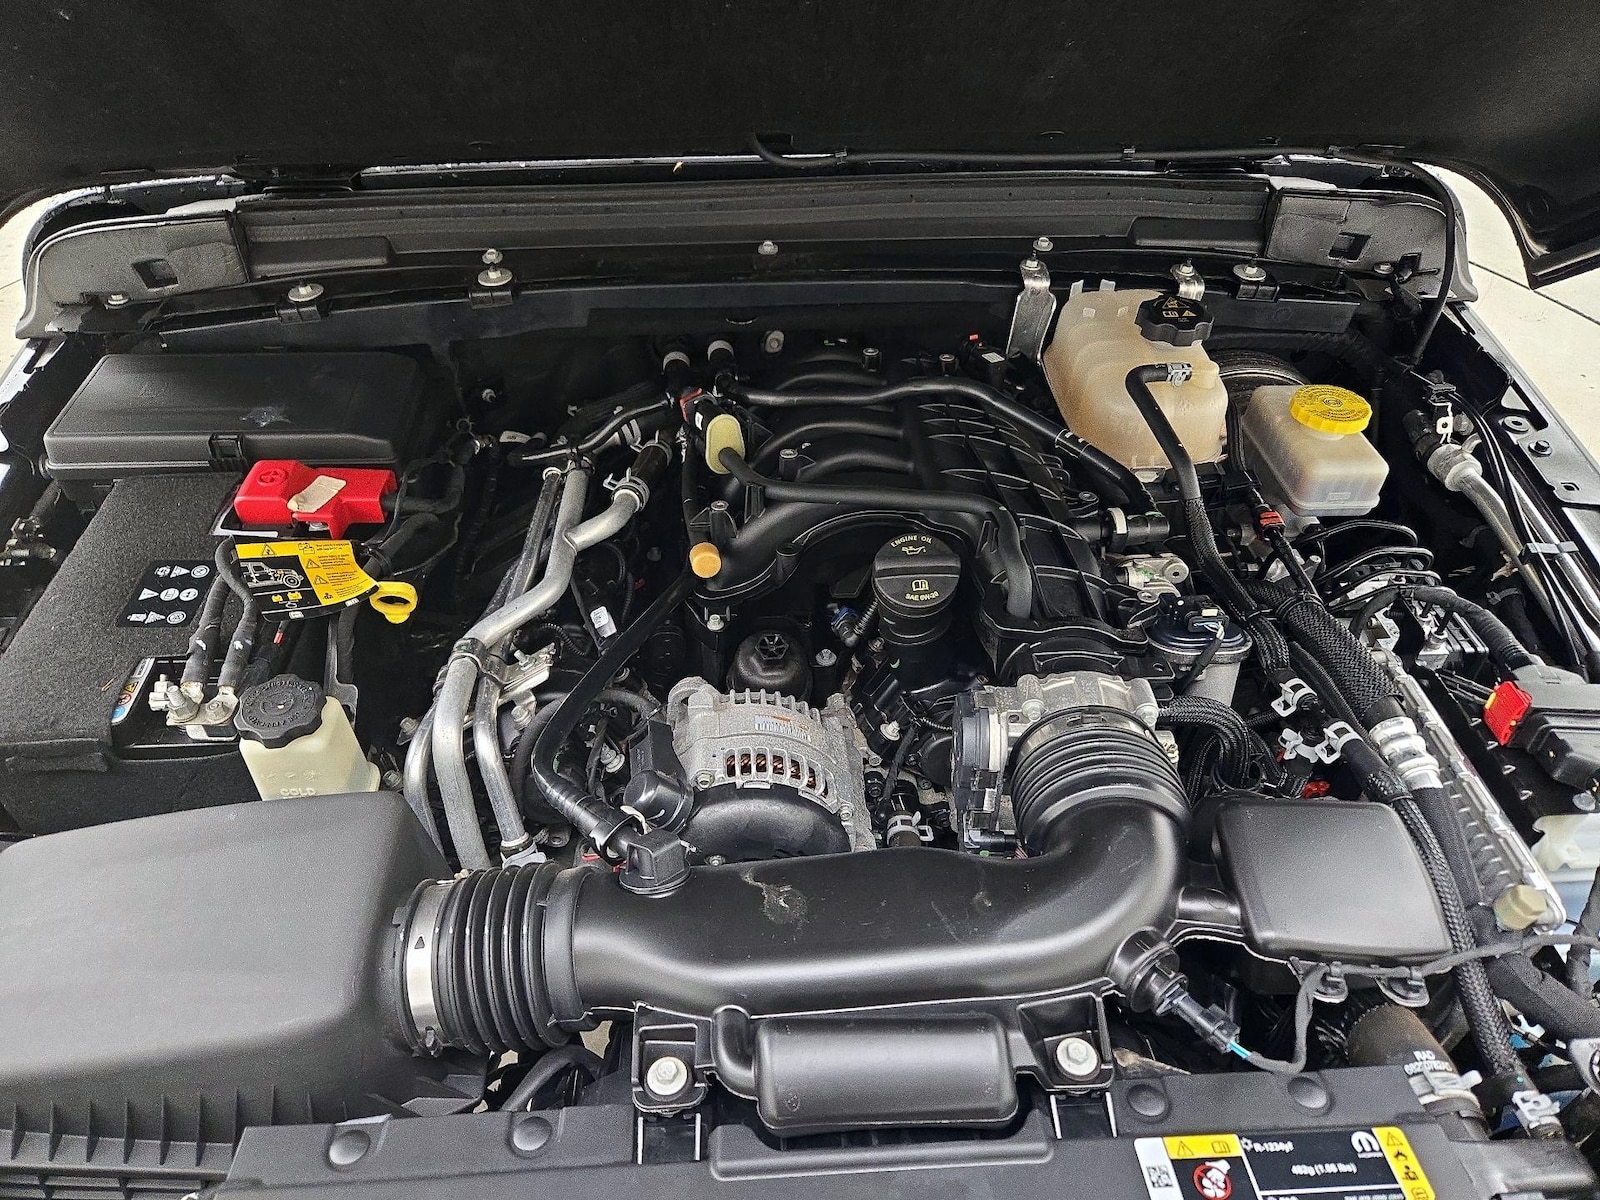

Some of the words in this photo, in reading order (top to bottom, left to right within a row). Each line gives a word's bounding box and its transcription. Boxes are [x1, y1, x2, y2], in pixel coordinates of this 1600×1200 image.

[890, 535, 918, 547] ENGINE
[921, 536, 933, 544] OIL
[905, 593, 919, 601] SAE
[280, 787, 317, 796] COLD
[1413, 1051, 1436, 1061] RAD
